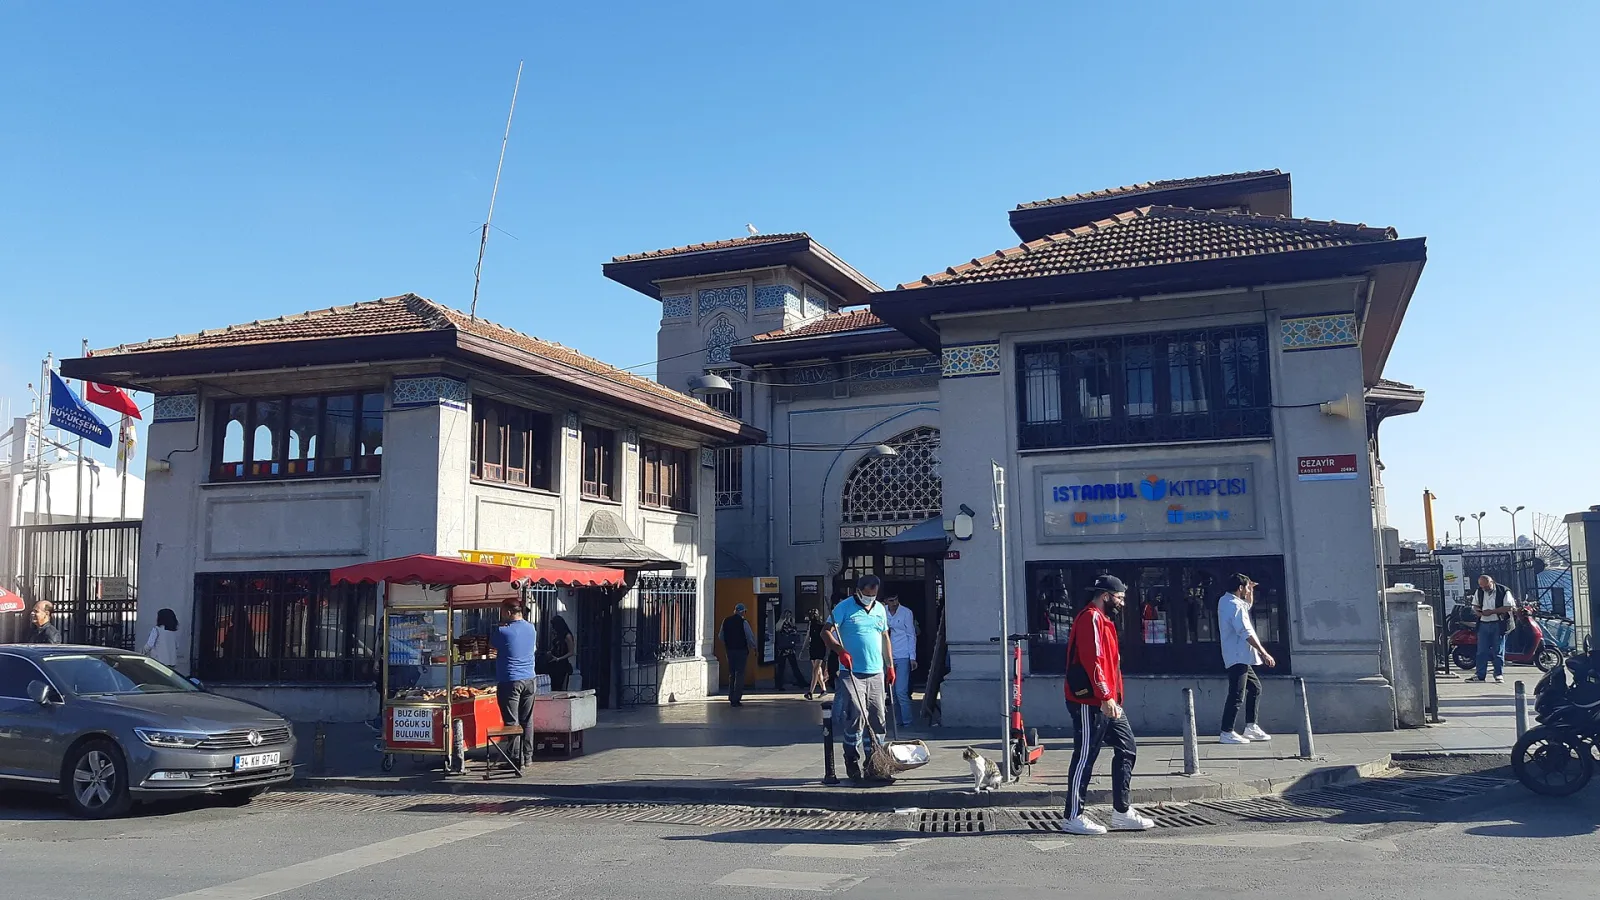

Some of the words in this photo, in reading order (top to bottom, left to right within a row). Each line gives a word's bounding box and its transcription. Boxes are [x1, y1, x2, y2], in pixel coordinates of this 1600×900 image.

[1300, 458, 1335, 468] CEZAYİR
[397, 709, 412, 718] BUZ
[394, 719, 420, 728] SOĞUK
[421, 720, 431, 728] SU
[395, 730, 430, 738] BULUNUR
[240, 757, 248, 768] 34
[251, 755, 260, 766] KH
[261, 753, 278, 765] 8740
